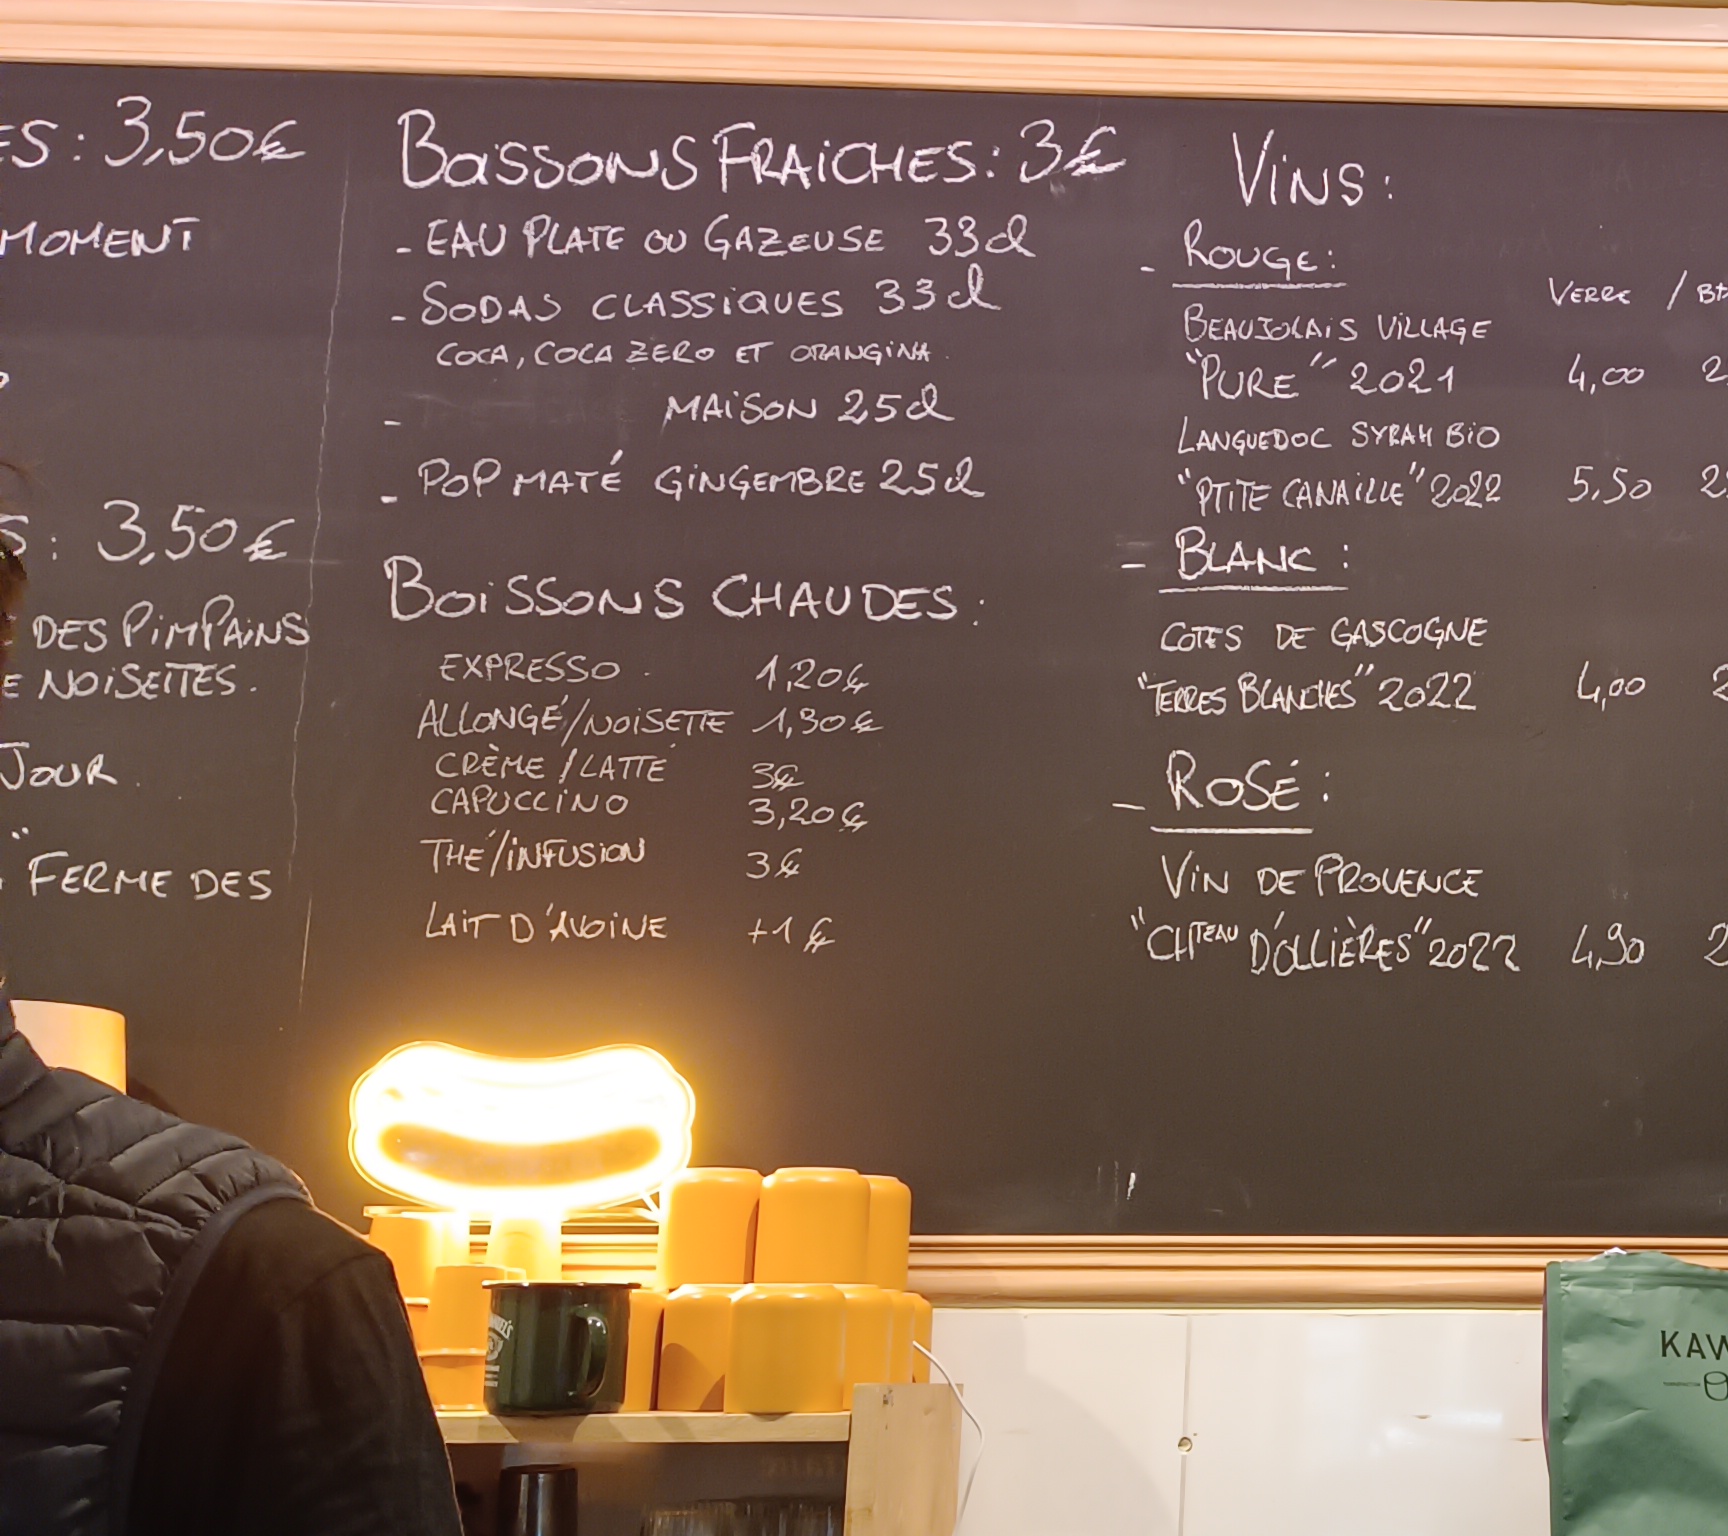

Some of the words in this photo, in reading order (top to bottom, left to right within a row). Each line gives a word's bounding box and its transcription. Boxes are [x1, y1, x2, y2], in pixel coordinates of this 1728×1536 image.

[104, 95, 307, 168] 3,50€
[1018, 118, 1127, 184] 3€
[0, 216, 201, 259] MOMENT
[426, 218, 507, 259] EAU
[521, 213, 626, 259] PLATE
[643, 228, 688, 255] OU
[704, 213, 885, 261] GAZEUSE
[421, 280, 562, 326] SODAS
[591, 289, 844, 321] CLASSIQUES
[1377, 314, 1493, 346] VILLAGE
[533, 340, 613, 366] COCA
[625, 340, 716, 364] ZERO
[735, 341, 775, 364] ET
[1349, 357, 1455, 396] 2021
[1567, 352, 1645, 395] 4,00
[660, 388, 818, 428] MAISON
[1177, 415, 1333, 457] LANGUEDOC
[1445, 421, 1501, 449] BIO
[417, 457, 502, 498] POP
[653, 463, 866, 502] GINGEMBRE
[1430, 470, 1502, 509] 2022
[1567, 465, 1652, 505] 5,50
[97, 499, 296, 566] 3,50€
[383, 554, 685, 622] BOISSONS
[32, 614, 107, 652] DES
[1275, 623, 1316, 651] DE
[1330, 615, 1489, 653] GASCOGNE
[439, 650, 621, 683] EXPRESSO
[1377, 672, 1477, 712] 2022
[1576, 660, 1646, 712] 4,00
[430, 783, 629, 816] CAPUCCINO
[27, 850, 173, 898] FERME
[189, 868, 272, 901] DES
[1161, 849, 1229, 900] VIN
[1256, 866, 1307, 897] DE
[1314, 852, 1484, 898] PROVENCE
[425, 900, 502, 939] LAIT
